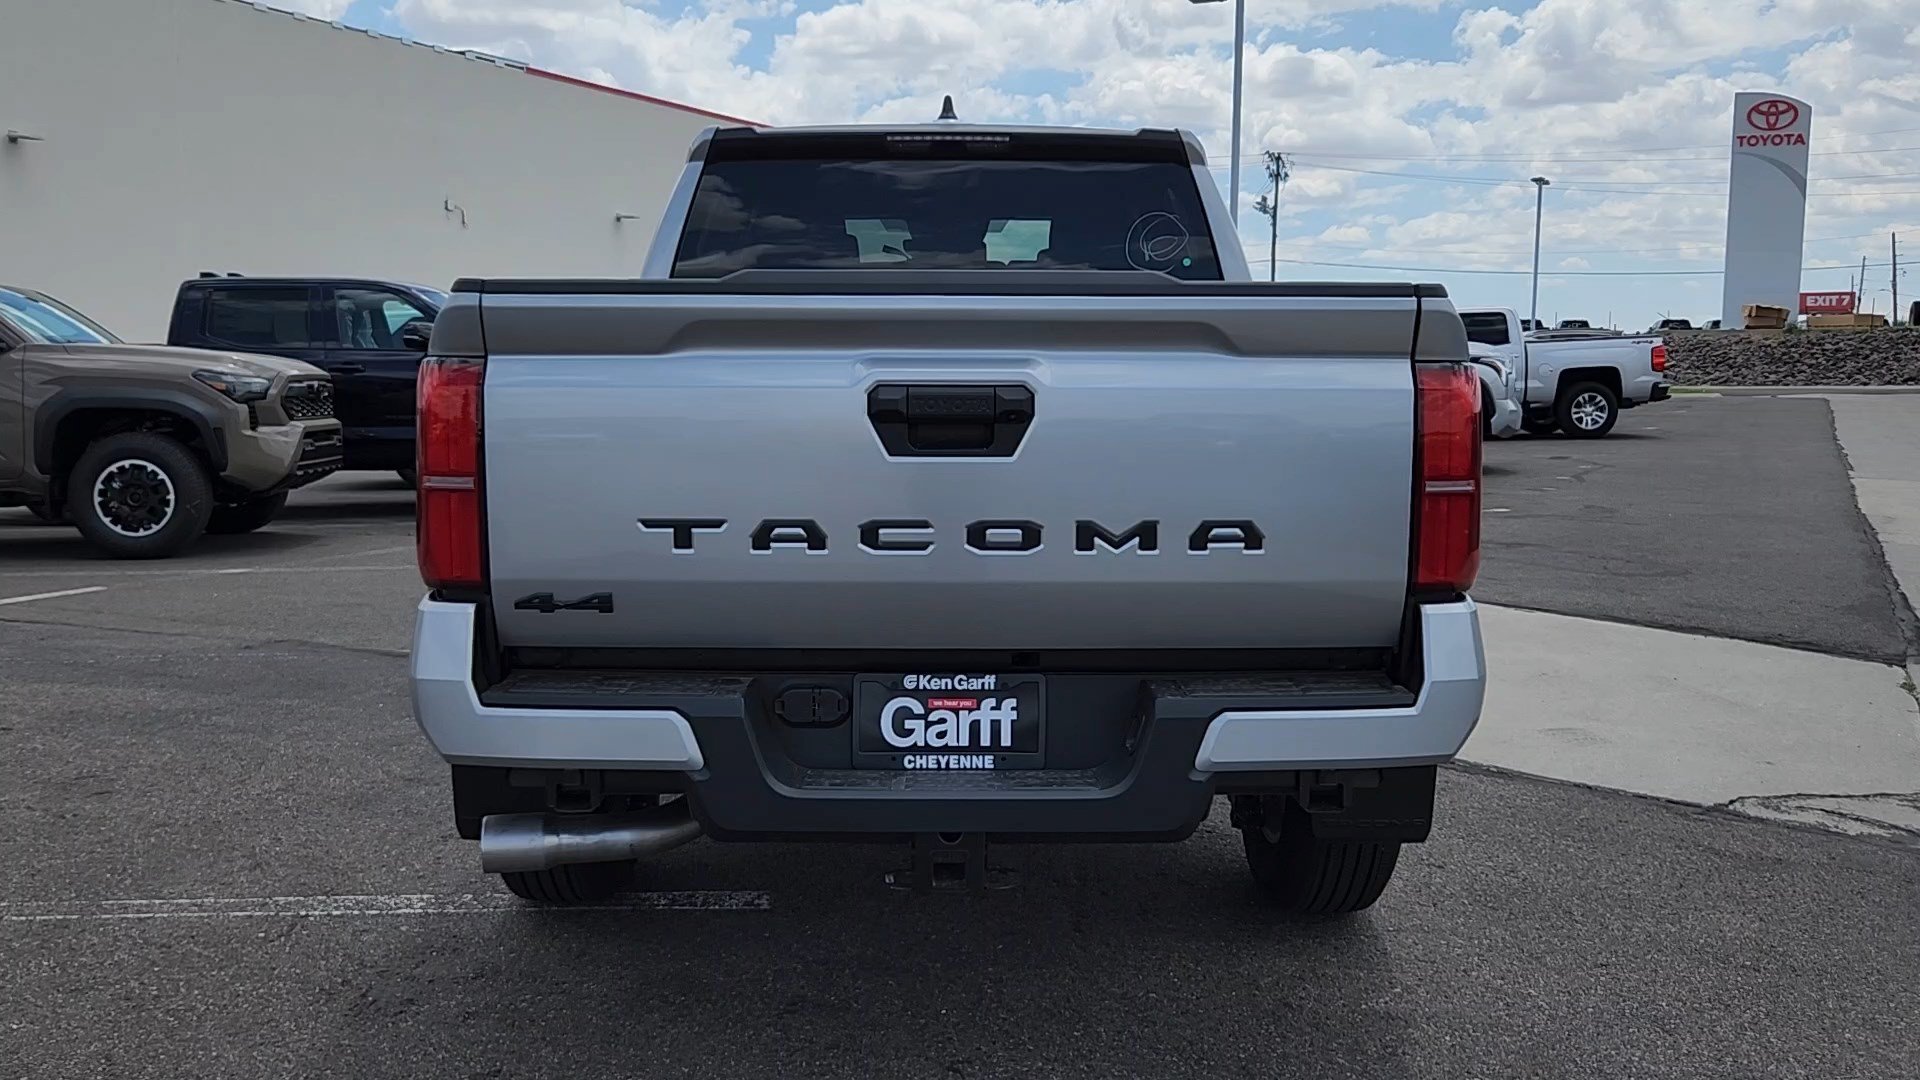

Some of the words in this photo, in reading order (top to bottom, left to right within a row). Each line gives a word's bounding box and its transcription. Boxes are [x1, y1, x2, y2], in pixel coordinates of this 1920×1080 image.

[1736, 133, 1806, 147] TOYOTA
[1806, 294, 1839, 307] EXIT
[1840, 294, 1851, 307] 7
[912, 398, 991, 412] TOYOTA
[636, 517, 1267, 556] TACOMA
[918, 674, 952, 690] Ken
[954, 674, 996, 690] Garff
[959, 700, 972, 708] you
[880, 696, 1017, 748] Garff
[903, 755, 995, 769] CHEYENNE
